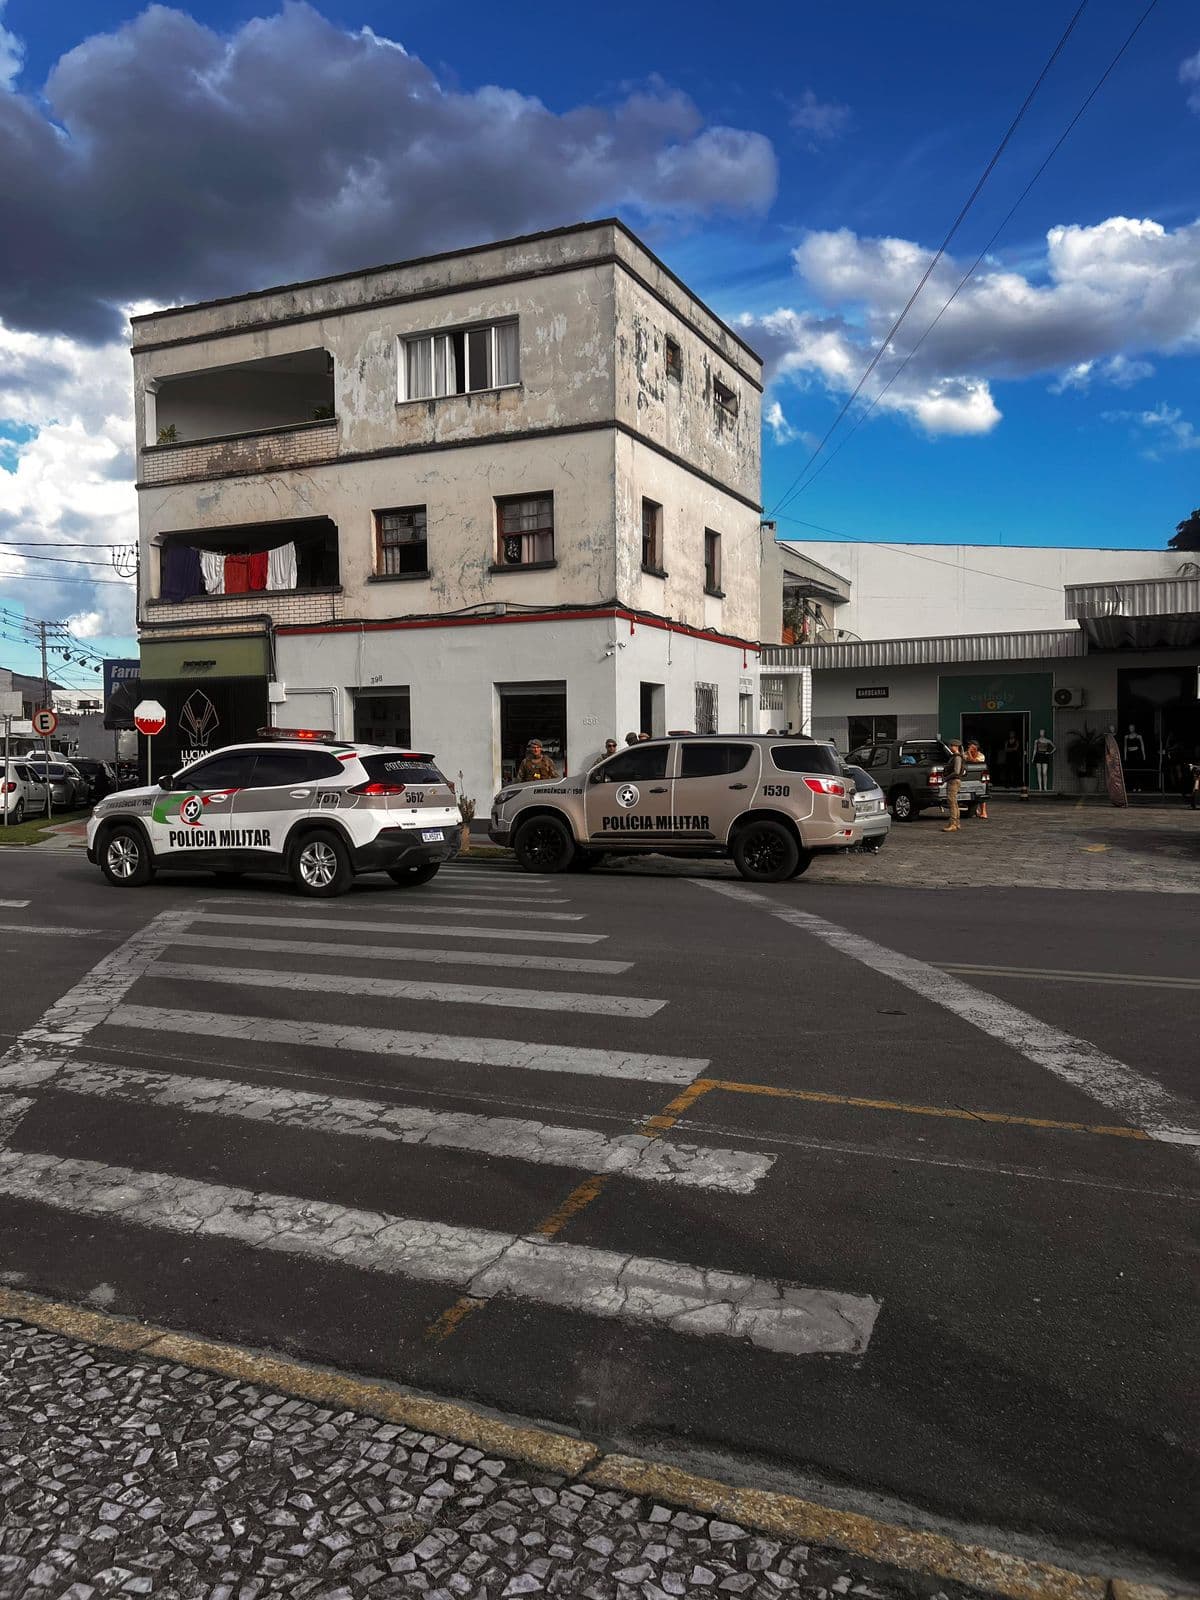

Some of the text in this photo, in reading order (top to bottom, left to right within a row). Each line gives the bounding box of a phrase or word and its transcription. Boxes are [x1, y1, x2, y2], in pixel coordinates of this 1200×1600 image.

[40, 714, 49, 729] E
[405, 791, 424, 803] 5612
[762, 785, 790, 797] 1530
[602, 813, 709, 831] POLÍCIA MILITAR
[169, 827, 271, 847] POLÍCIA MILITAR
